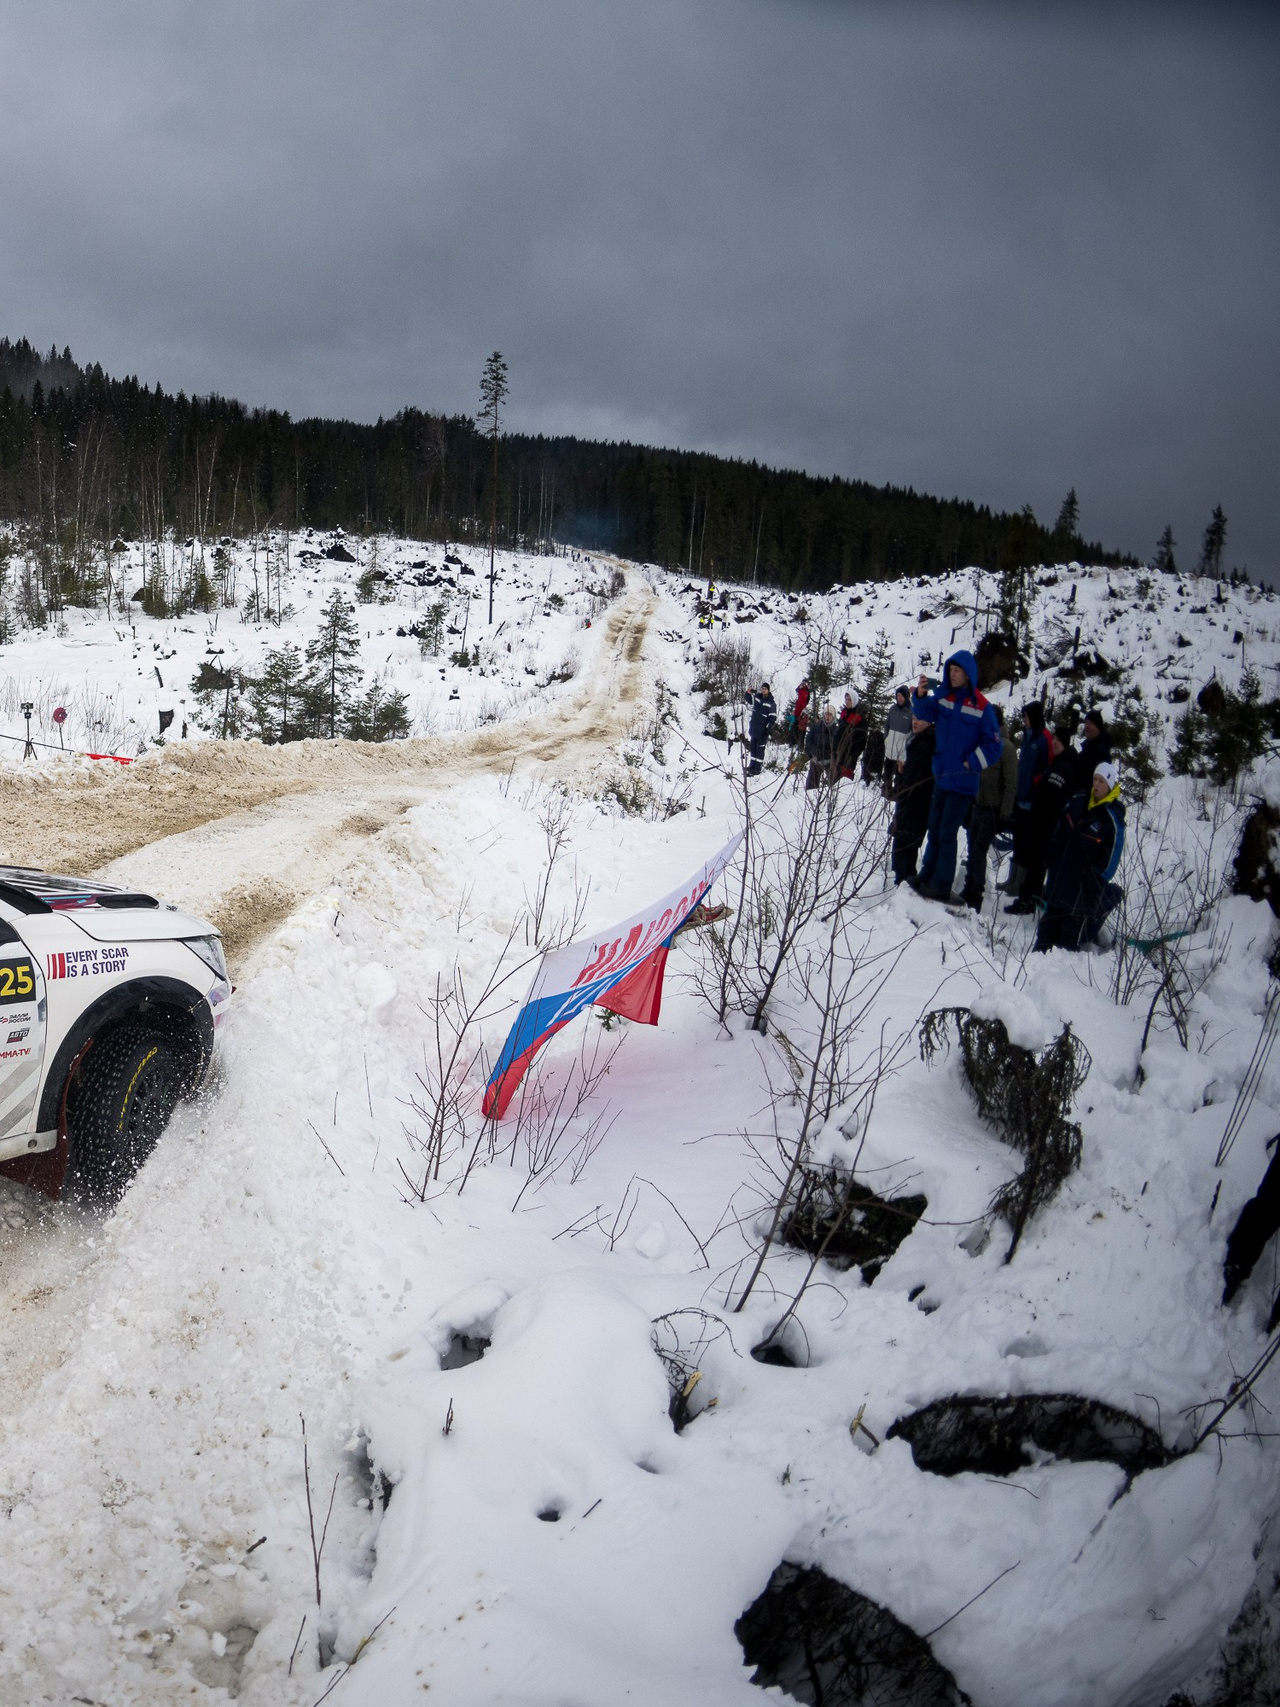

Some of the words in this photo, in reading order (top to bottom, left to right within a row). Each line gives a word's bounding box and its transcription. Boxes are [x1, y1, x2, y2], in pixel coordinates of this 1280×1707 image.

[65, 949, 98, 963] EVERY
[101, 947, 129, 960] SCAR
[66, 964, 78, 978] IS
[81, 964, 89, 976] A
[92, 960, 126, 975] STORY
